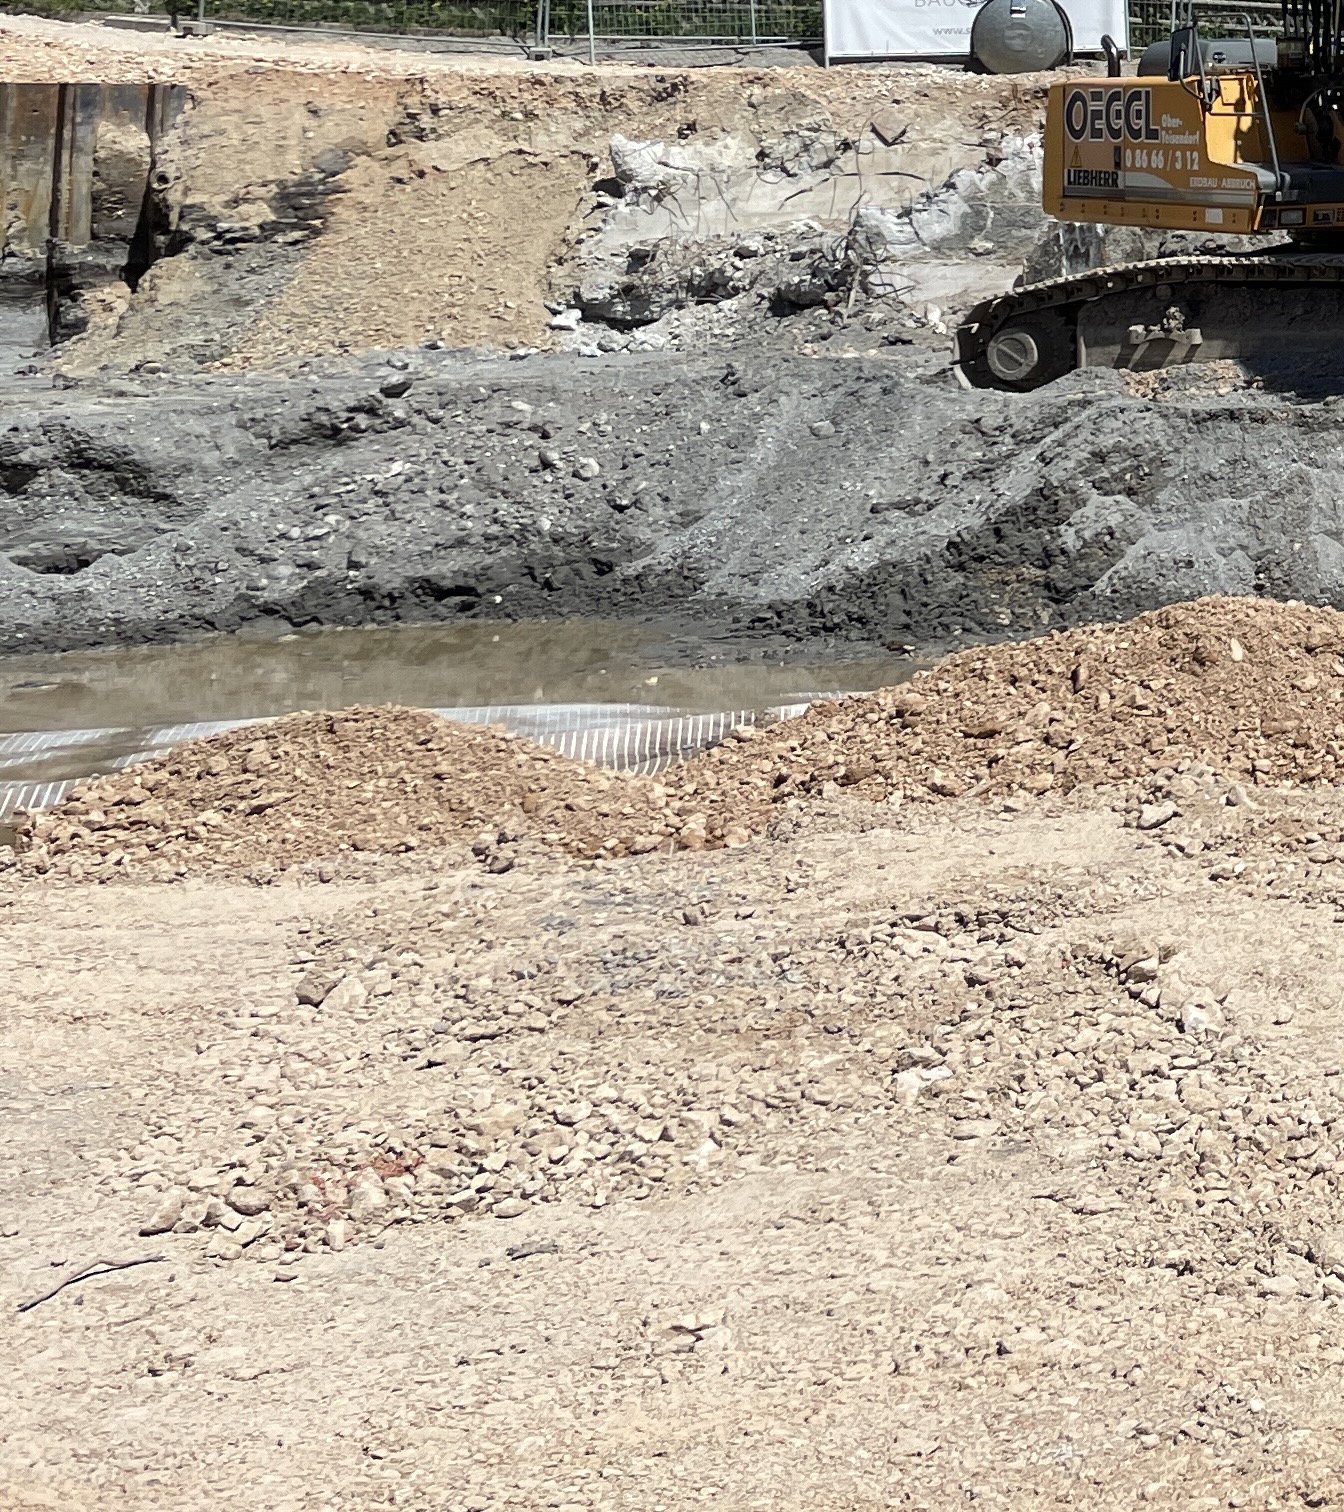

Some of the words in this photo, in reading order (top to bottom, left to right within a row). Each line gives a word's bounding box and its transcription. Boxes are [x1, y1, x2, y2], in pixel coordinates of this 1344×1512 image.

[1064, 88, 1160, 143] OEGGL
[1135, 149, 1148, 169] 86
[1151, 149, 1165, 169] 66
[1175, 150, 1183, 170] 3
[1186, 151, 1199, 170] 12
[1067, 169, 1119, 188] LIEBHERR
